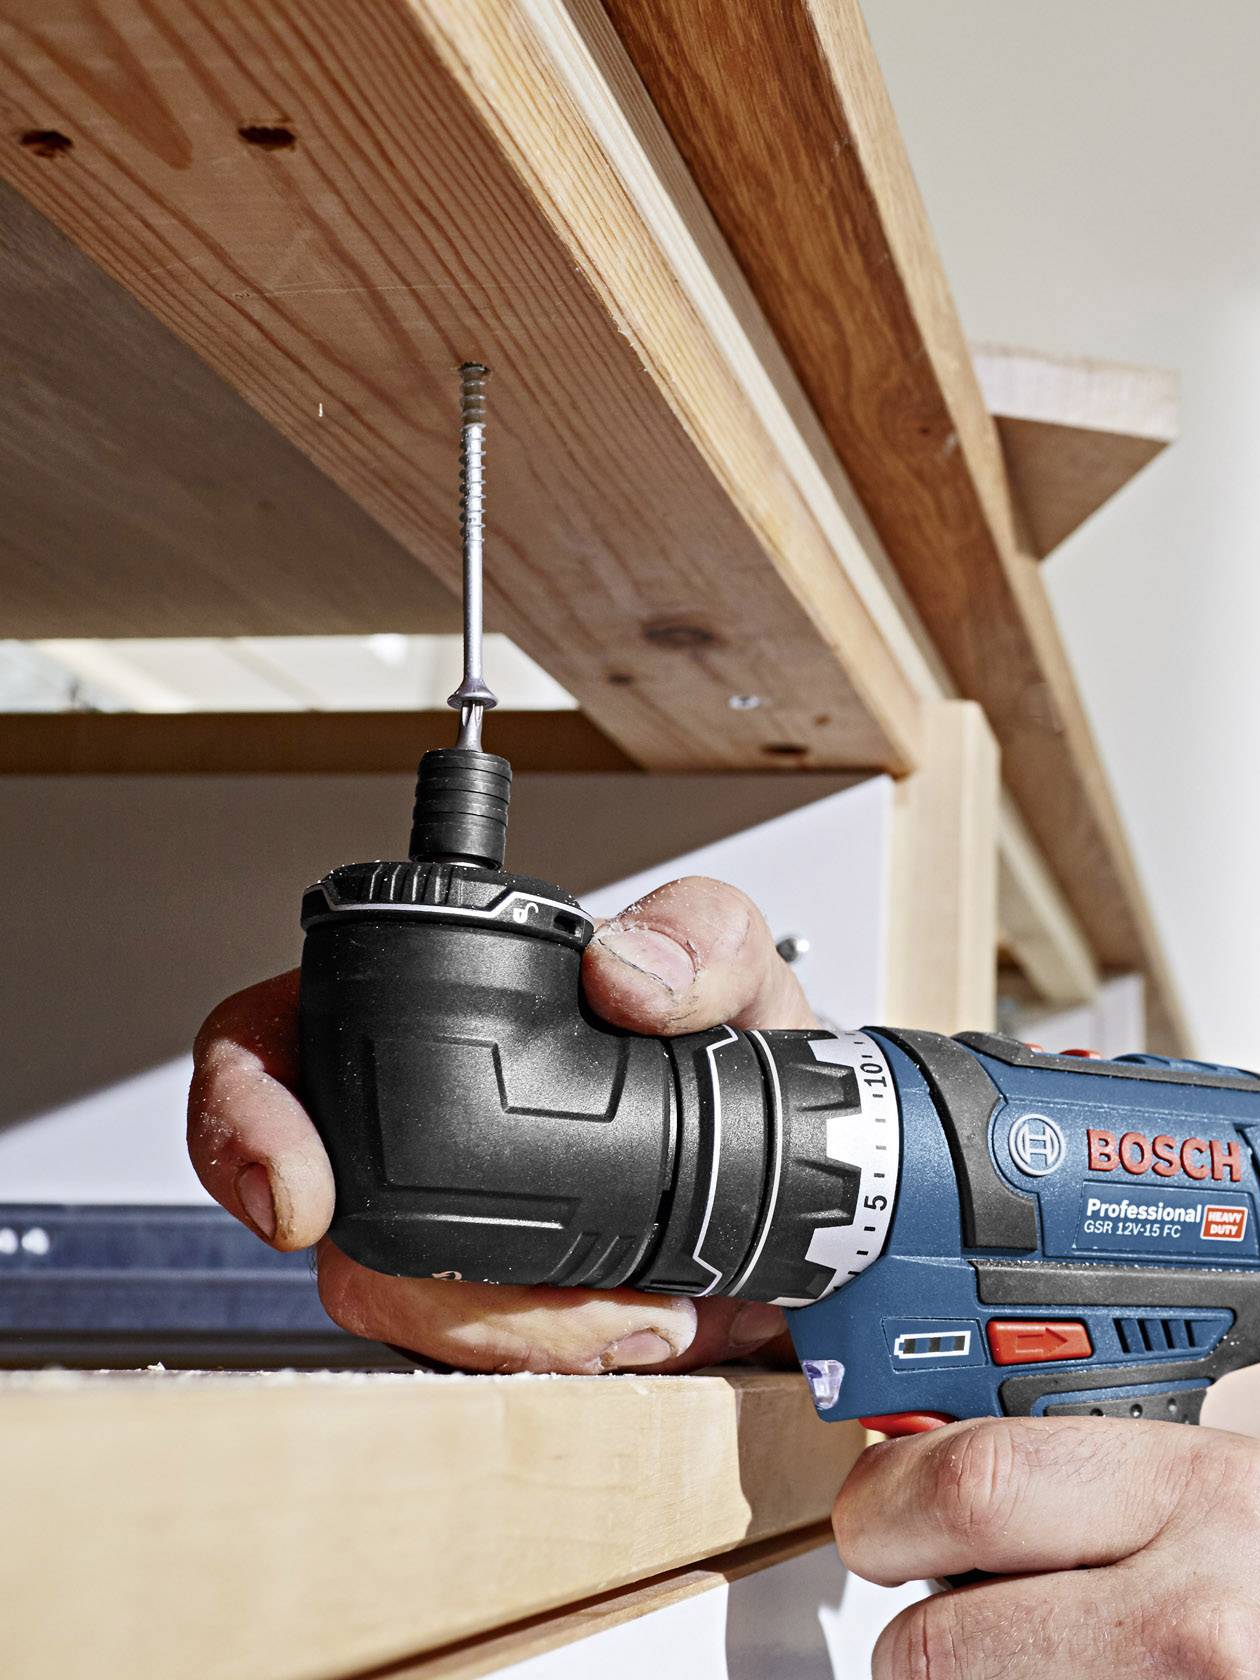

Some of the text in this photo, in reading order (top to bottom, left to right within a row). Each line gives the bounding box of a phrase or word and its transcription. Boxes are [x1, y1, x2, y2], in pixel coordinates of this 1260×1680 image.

[860, 1063, 887, 1088] 10
[1087, 1129, 1242, 1182] BOSCH
[863, 1195, 887, 1211] 5
[1086, 1198, 1202, 1223] Professional
[1208, 1211, 1243, 1223] HEAVY
[1084, 1220, 1182, 1238] GSR 12V-15 FC
[1210, 1223, 1239, 1236] DUTY
